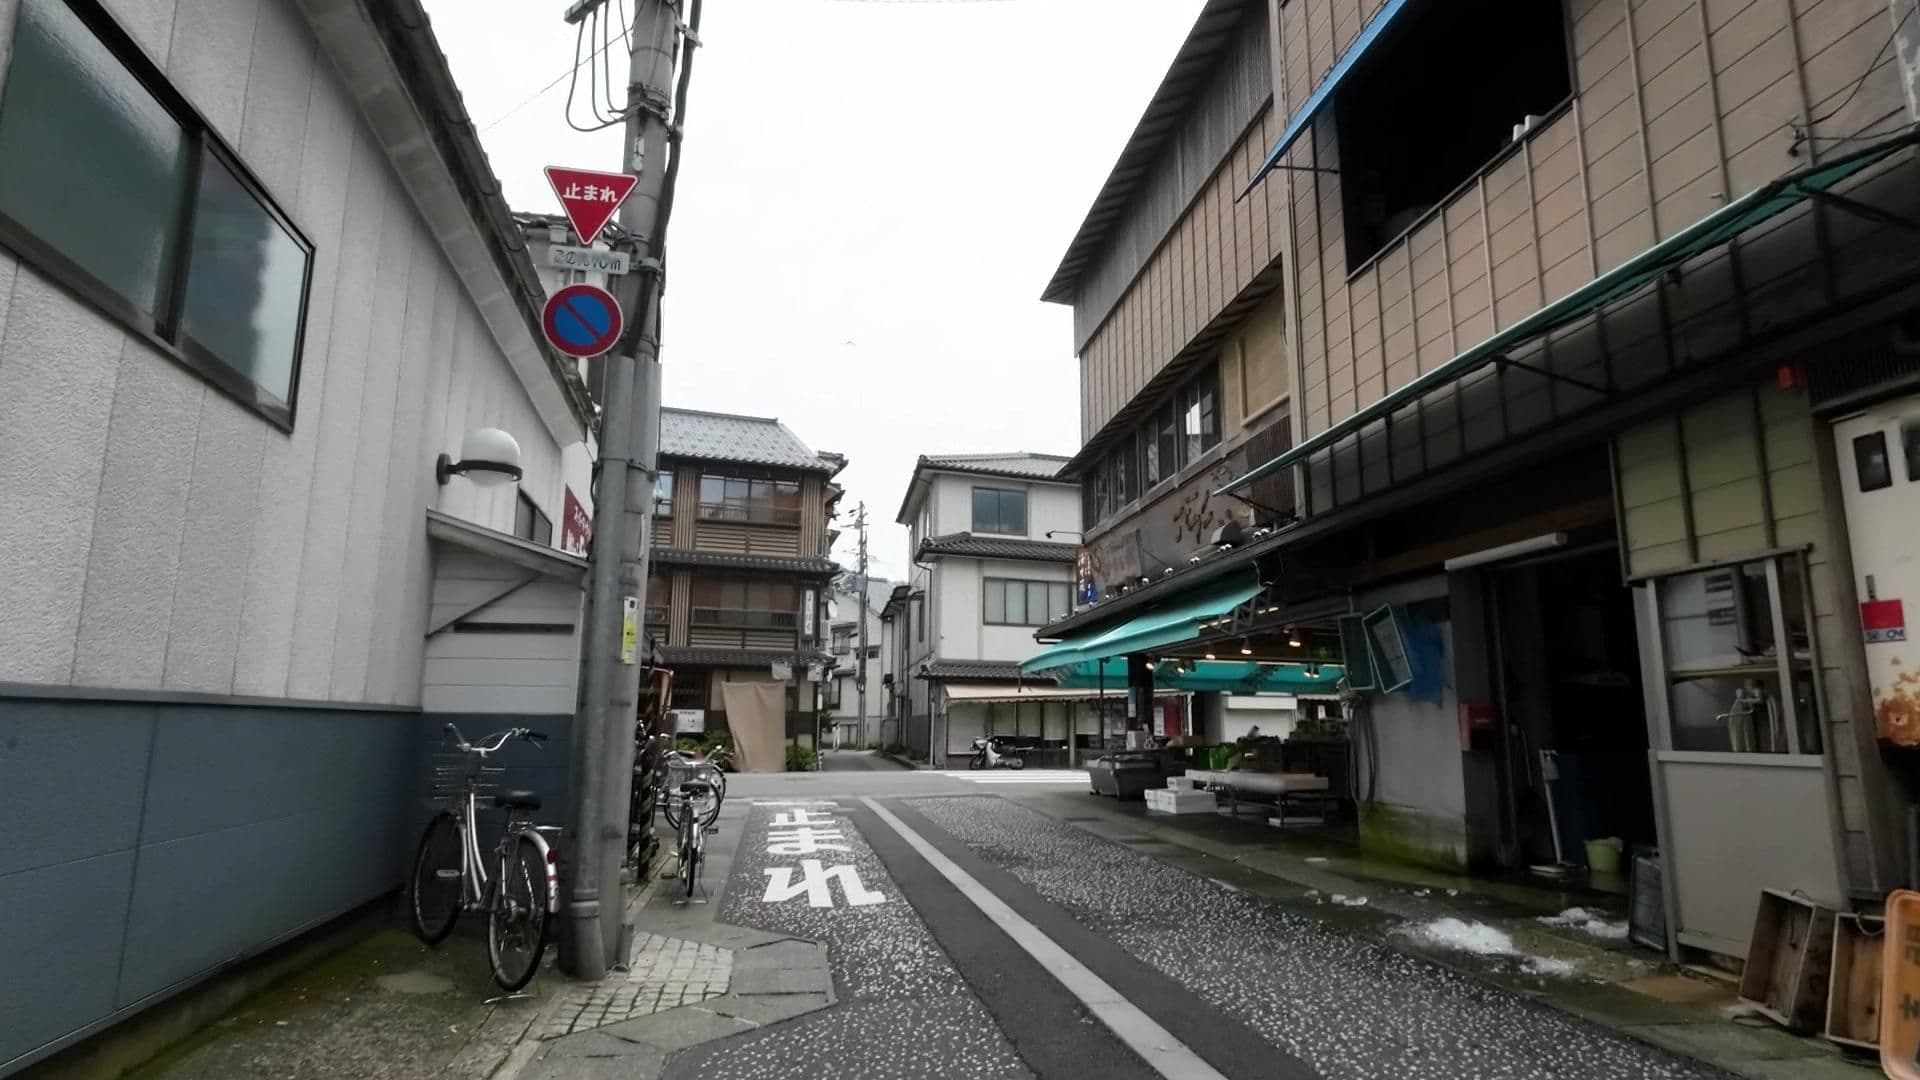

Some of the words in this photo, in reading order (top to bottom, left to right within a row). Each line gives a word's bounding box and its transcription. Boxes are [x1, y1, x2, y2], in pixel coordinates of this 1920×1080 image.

[563, 182, 617, 203] 止まれ
[762, 809, 886, 908] 止まれ
